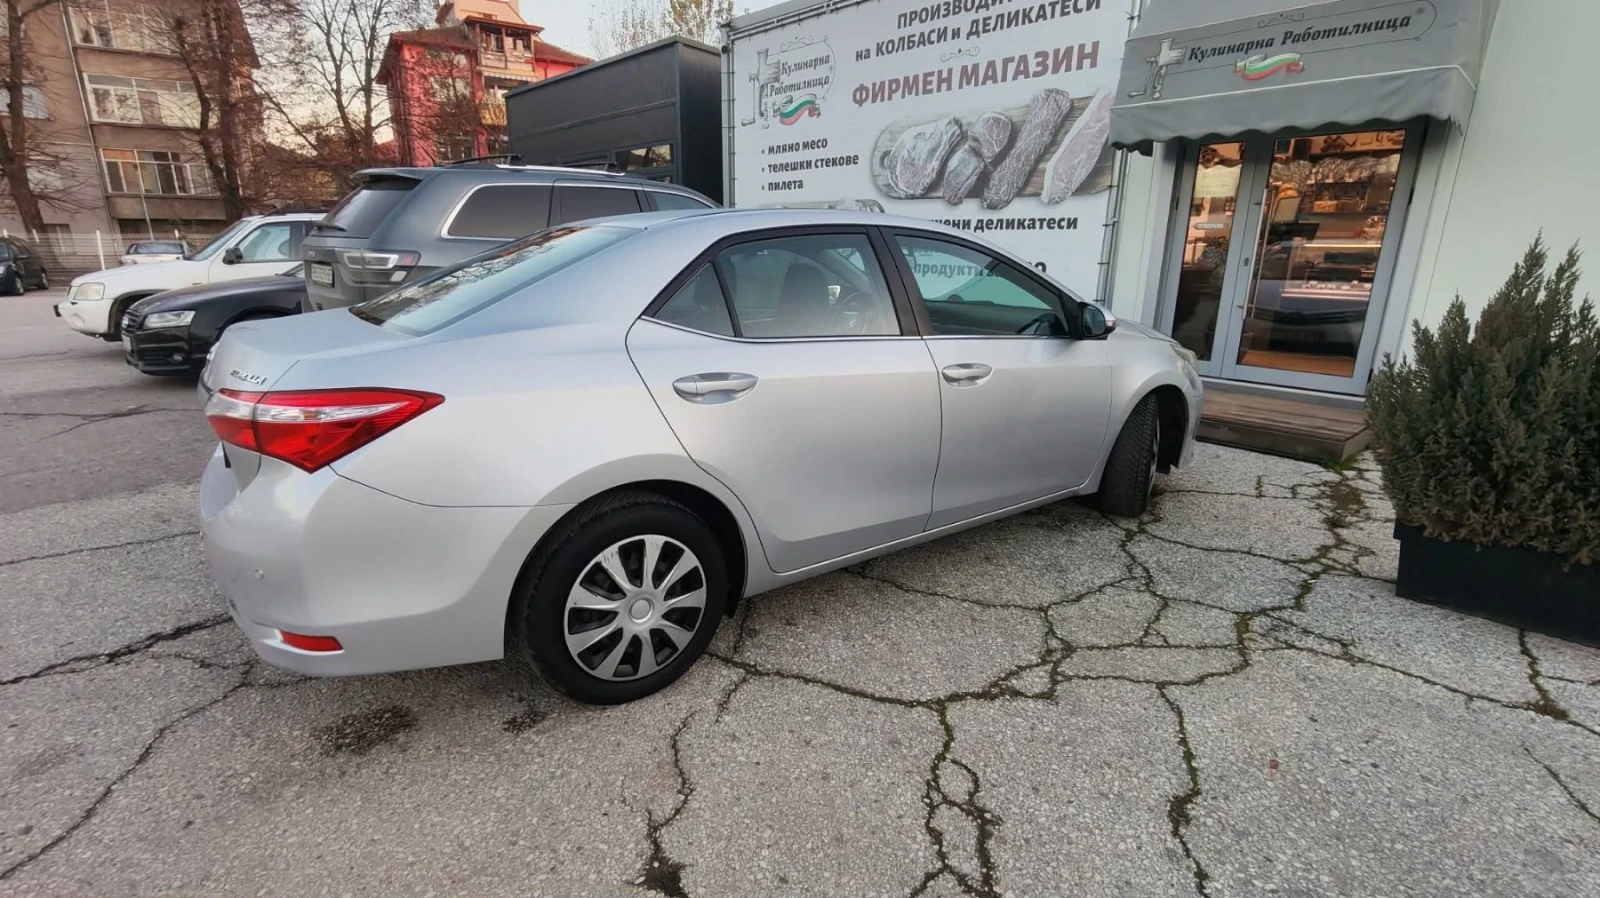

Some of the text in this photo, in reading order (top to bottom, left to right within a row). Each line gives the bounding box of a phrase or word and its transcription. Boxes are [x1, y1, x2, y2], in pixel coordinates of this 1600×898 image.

[897, 0, 1013, 29] ПРОИЗВОД
[855, 0, 1101, 61] на КОЛБАСИ и ДЕЛИКАТЕСИ
[1188, 15, 1411, 62] Кулинарна Работилница
[781, 54, 830, 77] Кулинарна
[852, 41, 1101, 107] ФИРМЕН МАГАЗИН
[769, 75, 830, 97] Работилница
[767, 138, 828, 155] мляно месо
[767, 154, 860, 173] телешки стекове
[767, 179, 804, 192] пилета
[973, 216, 1079, 233] деликатеси
